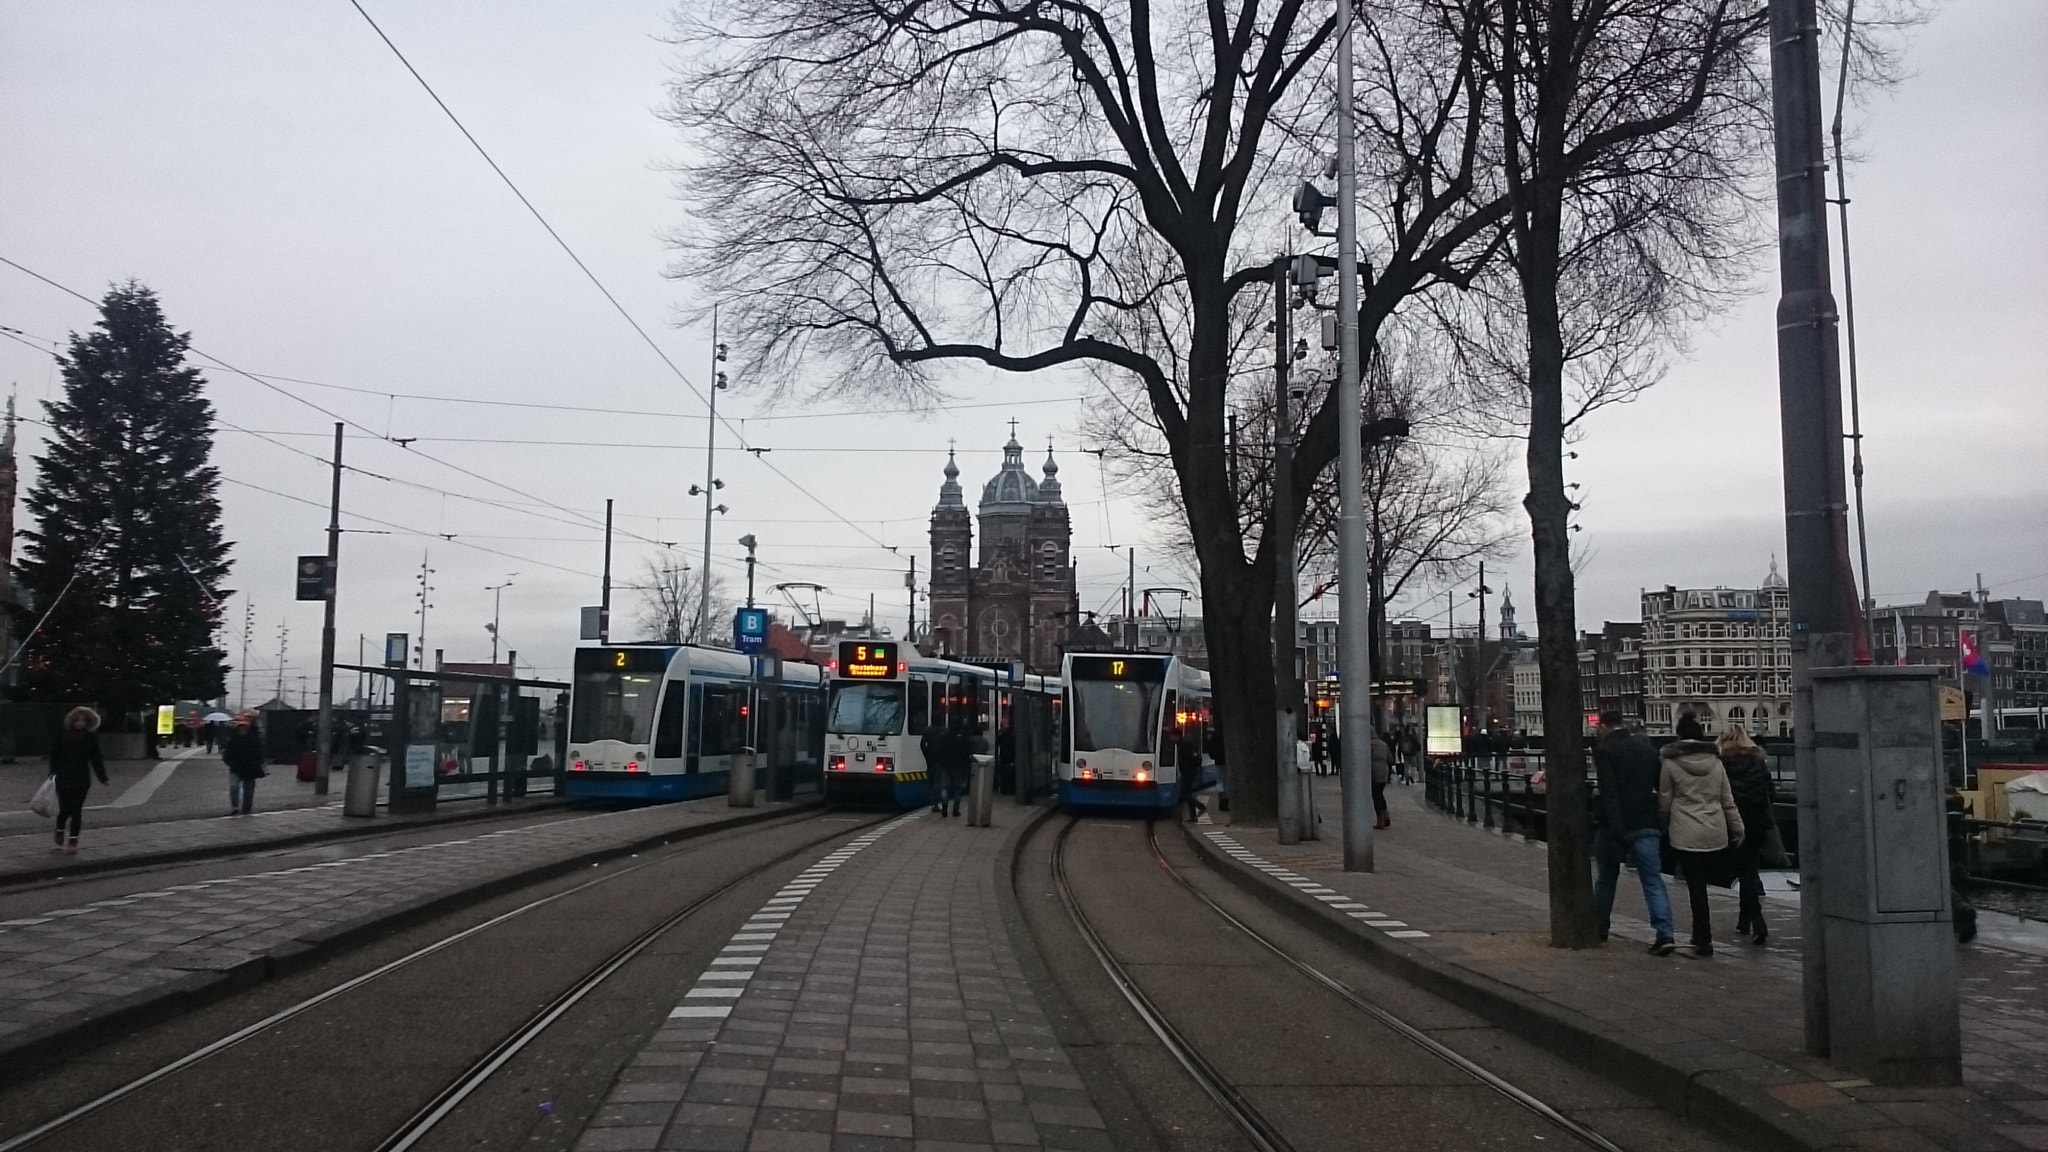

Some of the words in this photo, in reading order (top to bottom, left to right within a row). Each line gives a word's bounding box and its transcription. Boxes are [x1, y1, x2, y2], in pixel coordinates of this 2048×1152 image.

[747, 615, 757, 630] B
[741, 634, 762, 644] Tram
[617, 652, 625, 666] 2
[857, 646, 867, 661] 5
[1112, 661, 1124, 675] 17
